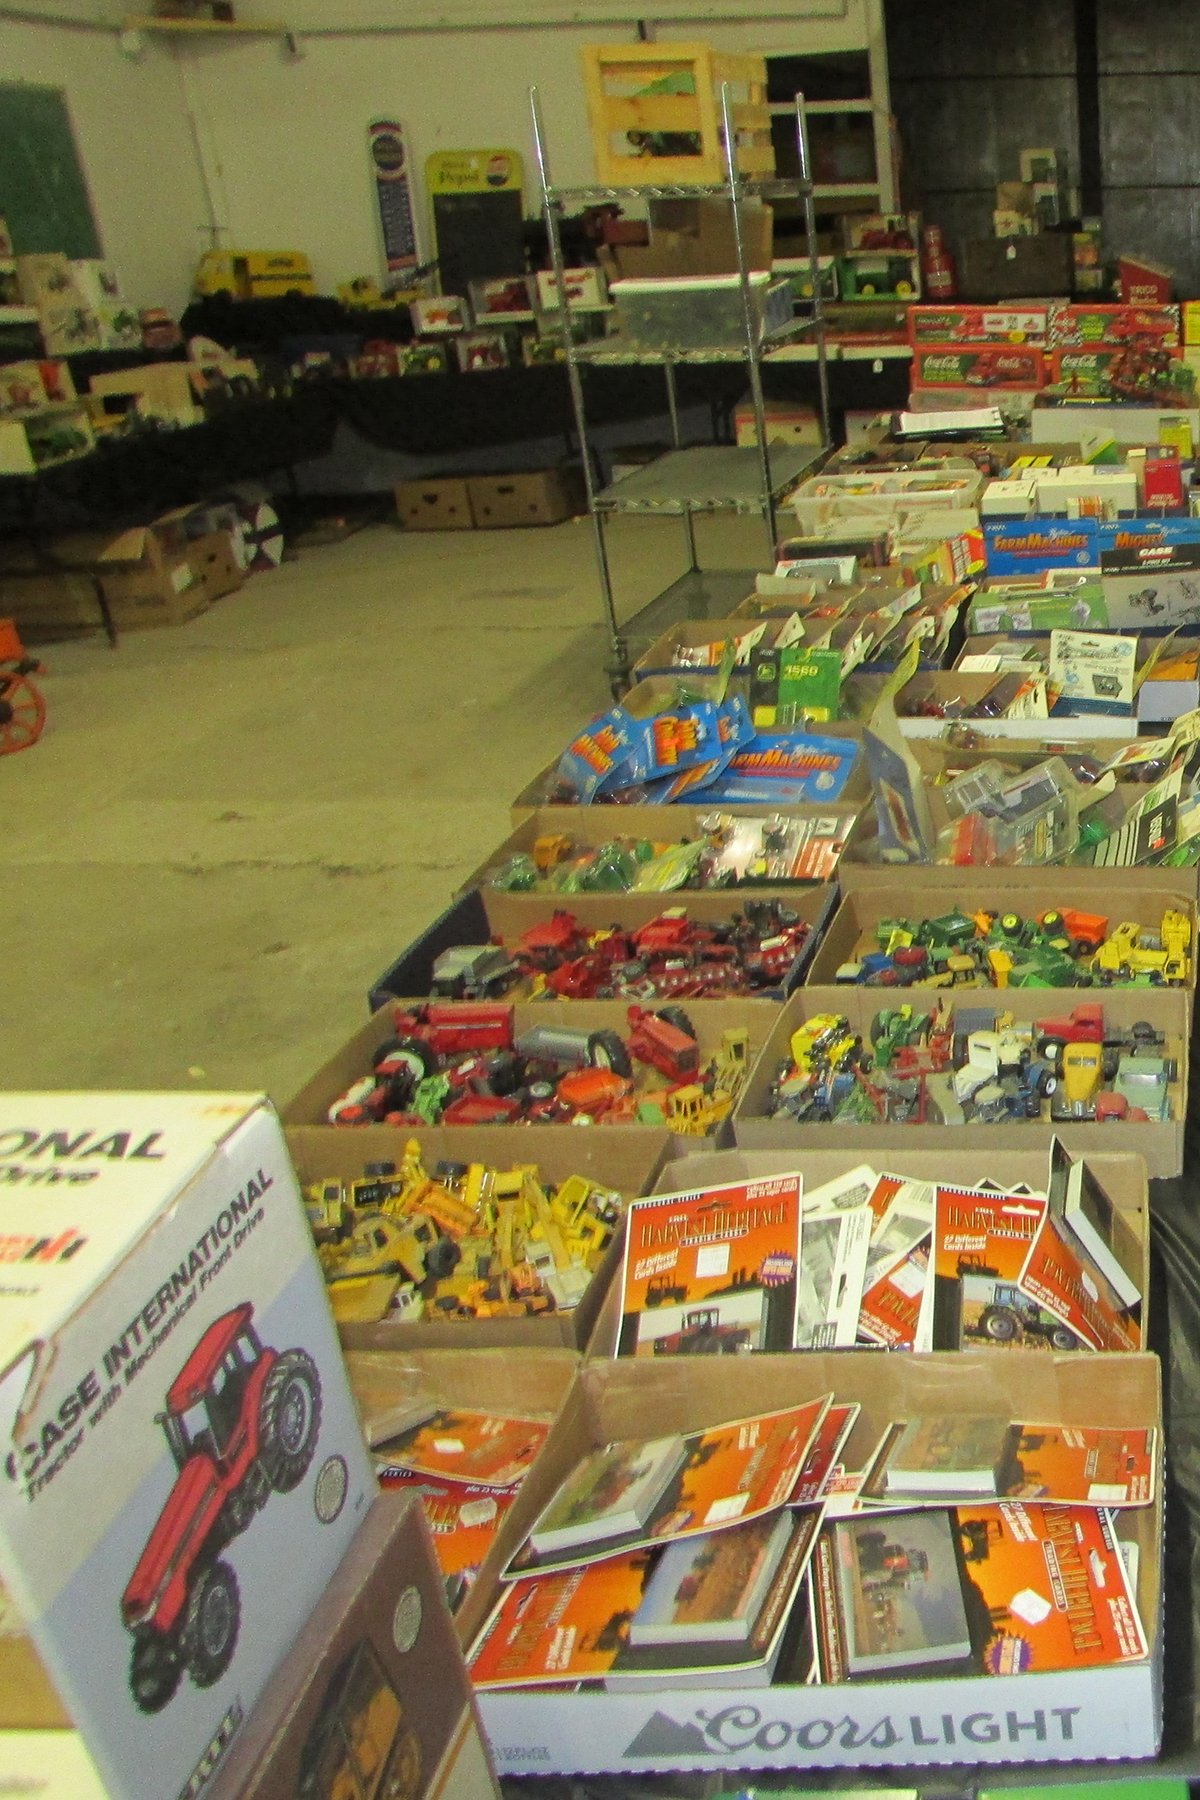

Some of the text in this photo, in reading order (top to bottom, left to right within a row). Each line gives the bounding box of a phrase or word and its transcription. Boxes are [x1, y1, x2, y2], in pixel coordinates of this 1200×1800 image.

[102, 1168, 273, 1379] INTERNATIONAL
[200, 1244, 233, 1291] Front
[233, 1207, 265, 1249] Drive
[465, 1485, 480, 1495] plus
[703, 1704, 1081, 1756] Coors LIGHT
